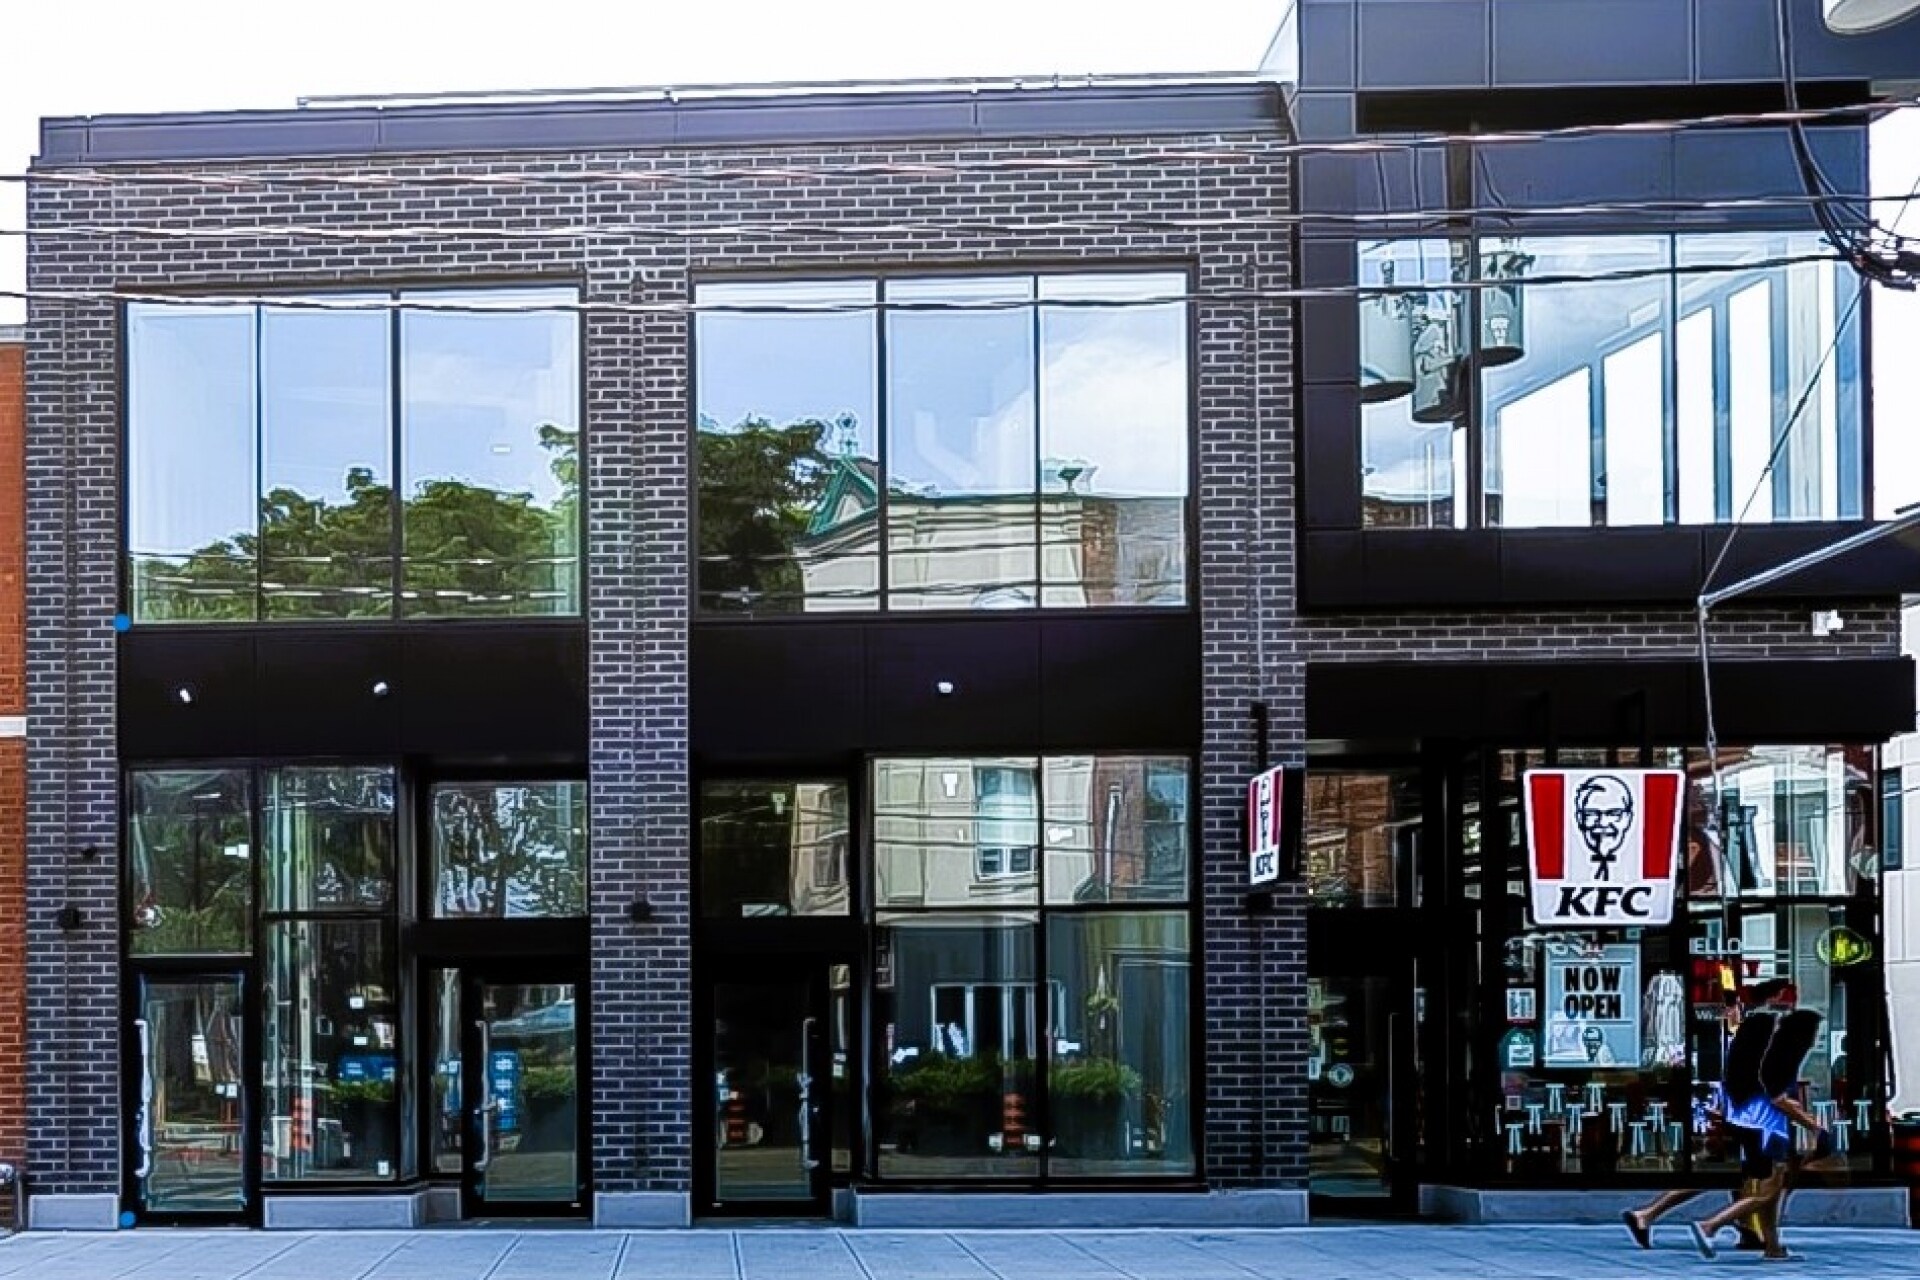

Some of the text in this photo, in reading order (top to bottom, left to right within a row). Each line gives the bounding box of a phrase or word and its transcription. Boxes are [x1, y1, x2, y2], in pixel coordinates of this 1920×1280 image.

[1554, 886, 1651, 917] KFC
[1564, 967, 1621, 992] NOW
[1564, 995, 1621, 1019] OPEN
